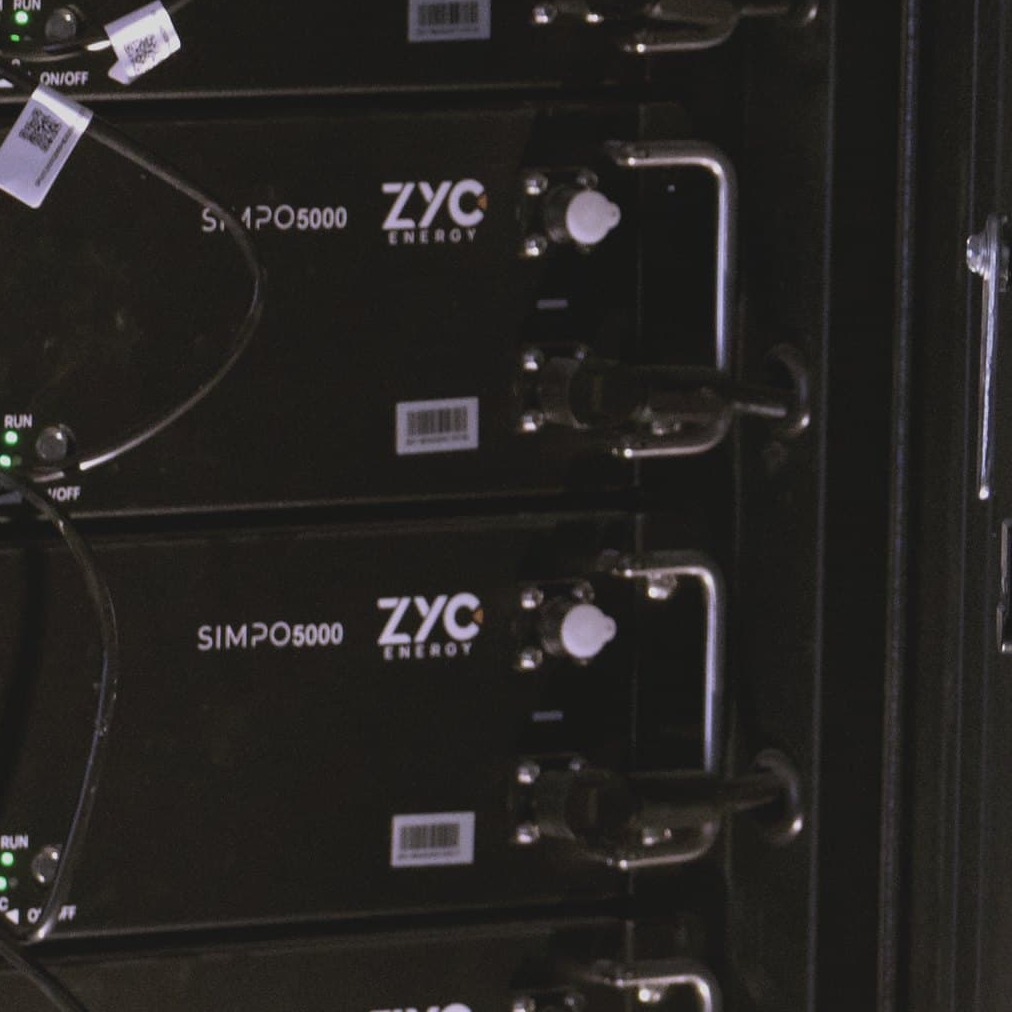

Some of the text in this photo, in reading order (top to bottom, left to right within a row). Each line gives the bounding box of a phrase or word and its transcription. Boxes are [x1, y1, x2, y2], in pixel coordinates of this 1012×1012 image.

[39, 70, 89, 87] ON/OFF
[381, 178, 488, 230] ZYC
[388, 227, 478, 246] ENERGY
[4, 414, 33, 429] RUN
[376, 591, 484, 646] ZYC
[196, 620, 344, 652] SIMPO5000
[382, 641, 473, 661] ENERGY
[0, 834, 29, 849] RUN
